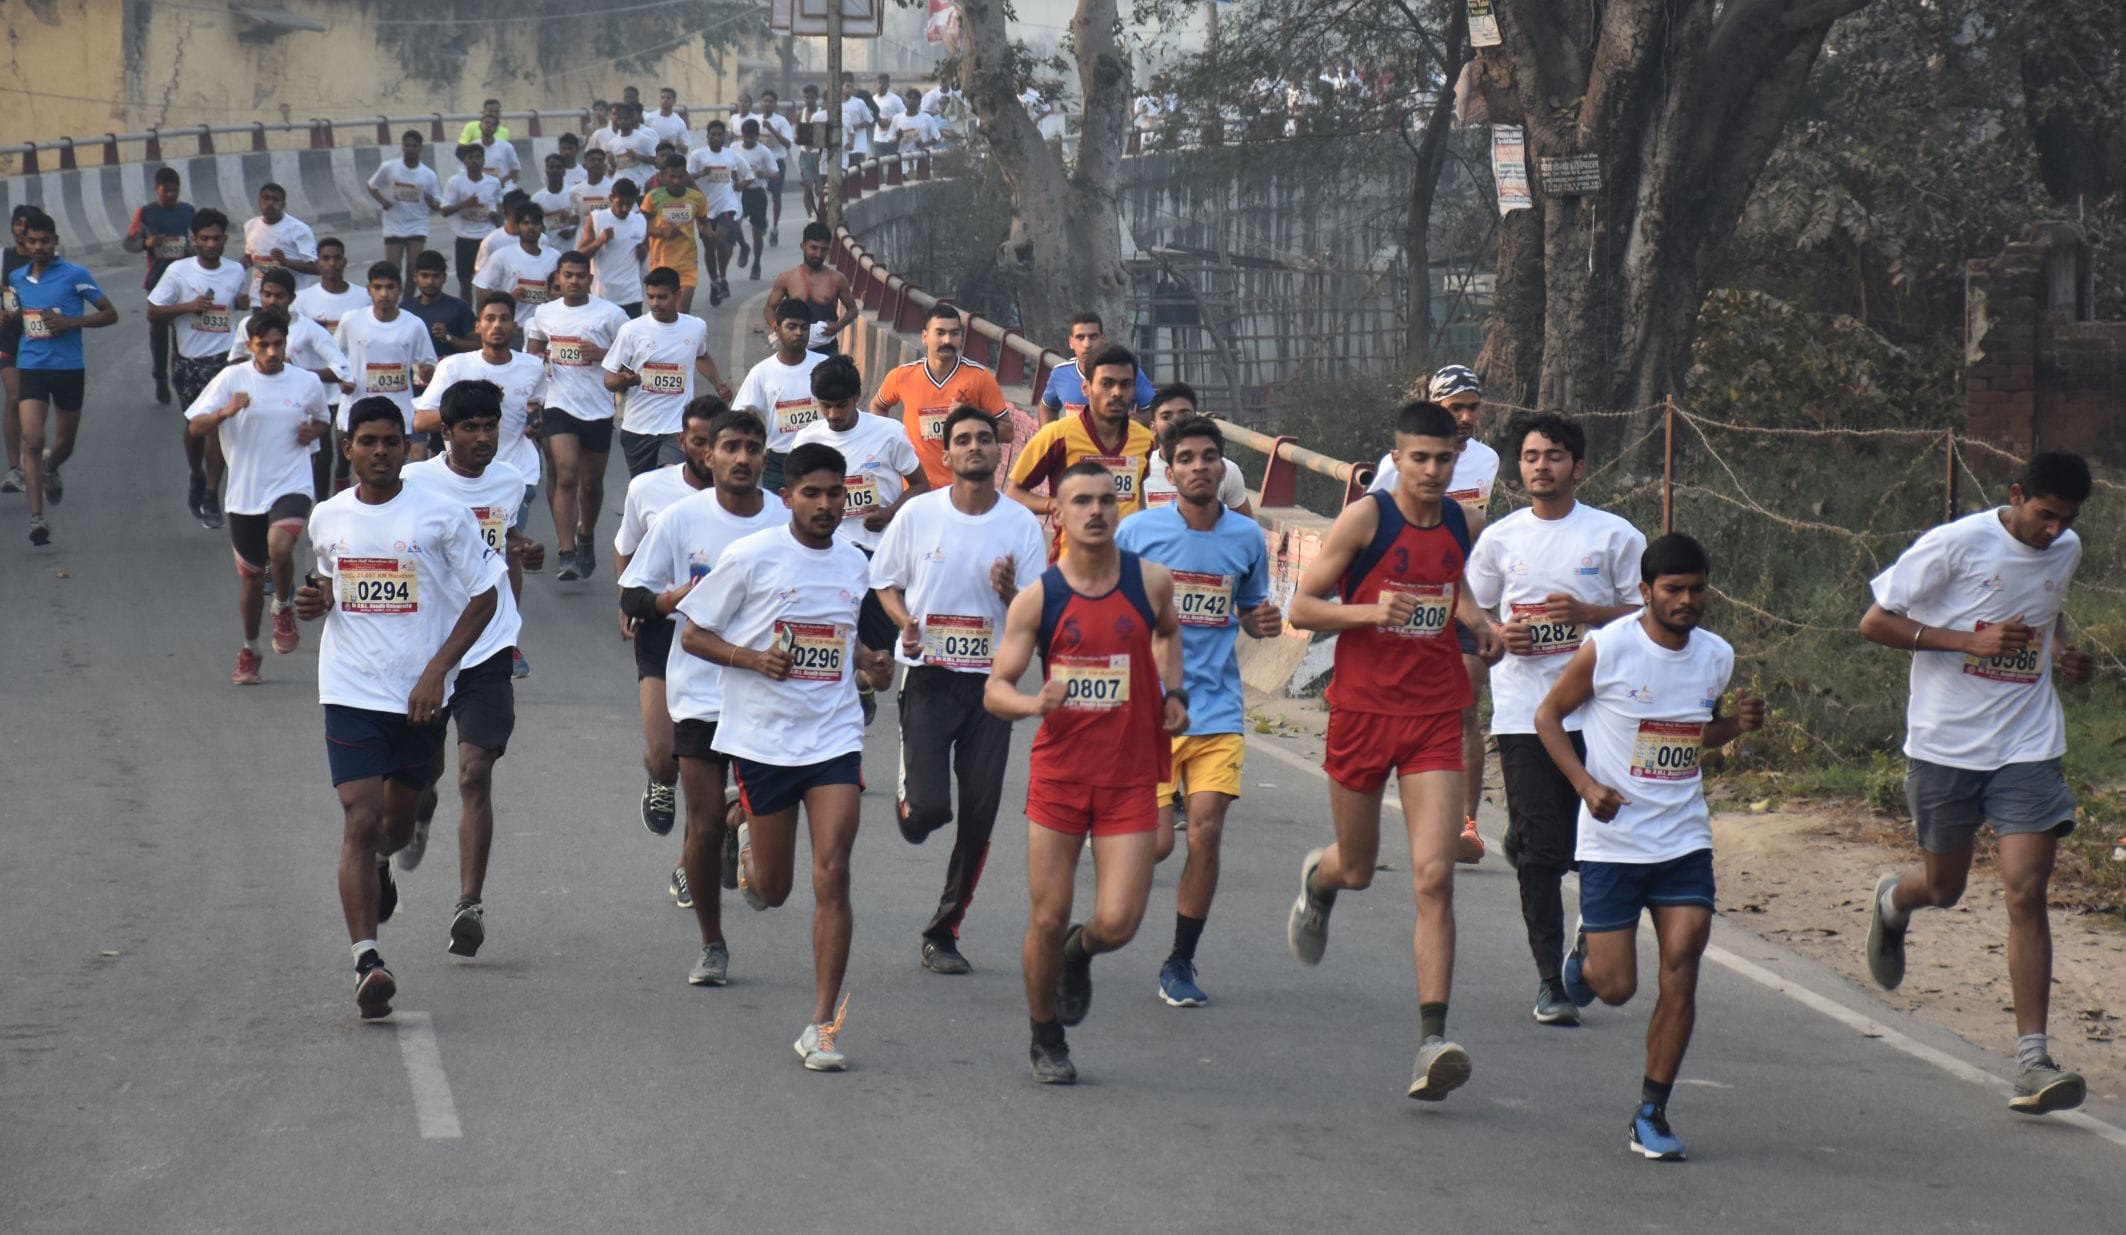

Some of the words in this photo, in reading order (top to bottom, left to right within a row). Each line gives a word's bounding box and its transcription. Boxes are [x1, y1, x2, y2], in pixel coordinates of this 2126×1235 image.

[560, 348, 580, 360] 029
[654, 376, 683, 388] 0529
[790, 410, 819, 425] 0224
[1114, 475, 1132, 492] 98
[846, 490, 873, 507] 105
[358, 581, 409, 601] 0294
[1183, 593, 1227, 615] 0742
[1408, 606, 1447, 628] 808
[1529, 623, 1578, 643] 0282
[946, 636, 989, 656] 0326
[794, 646, 840, 668] 0296
[1067, 678, 1121, 699] 0807
